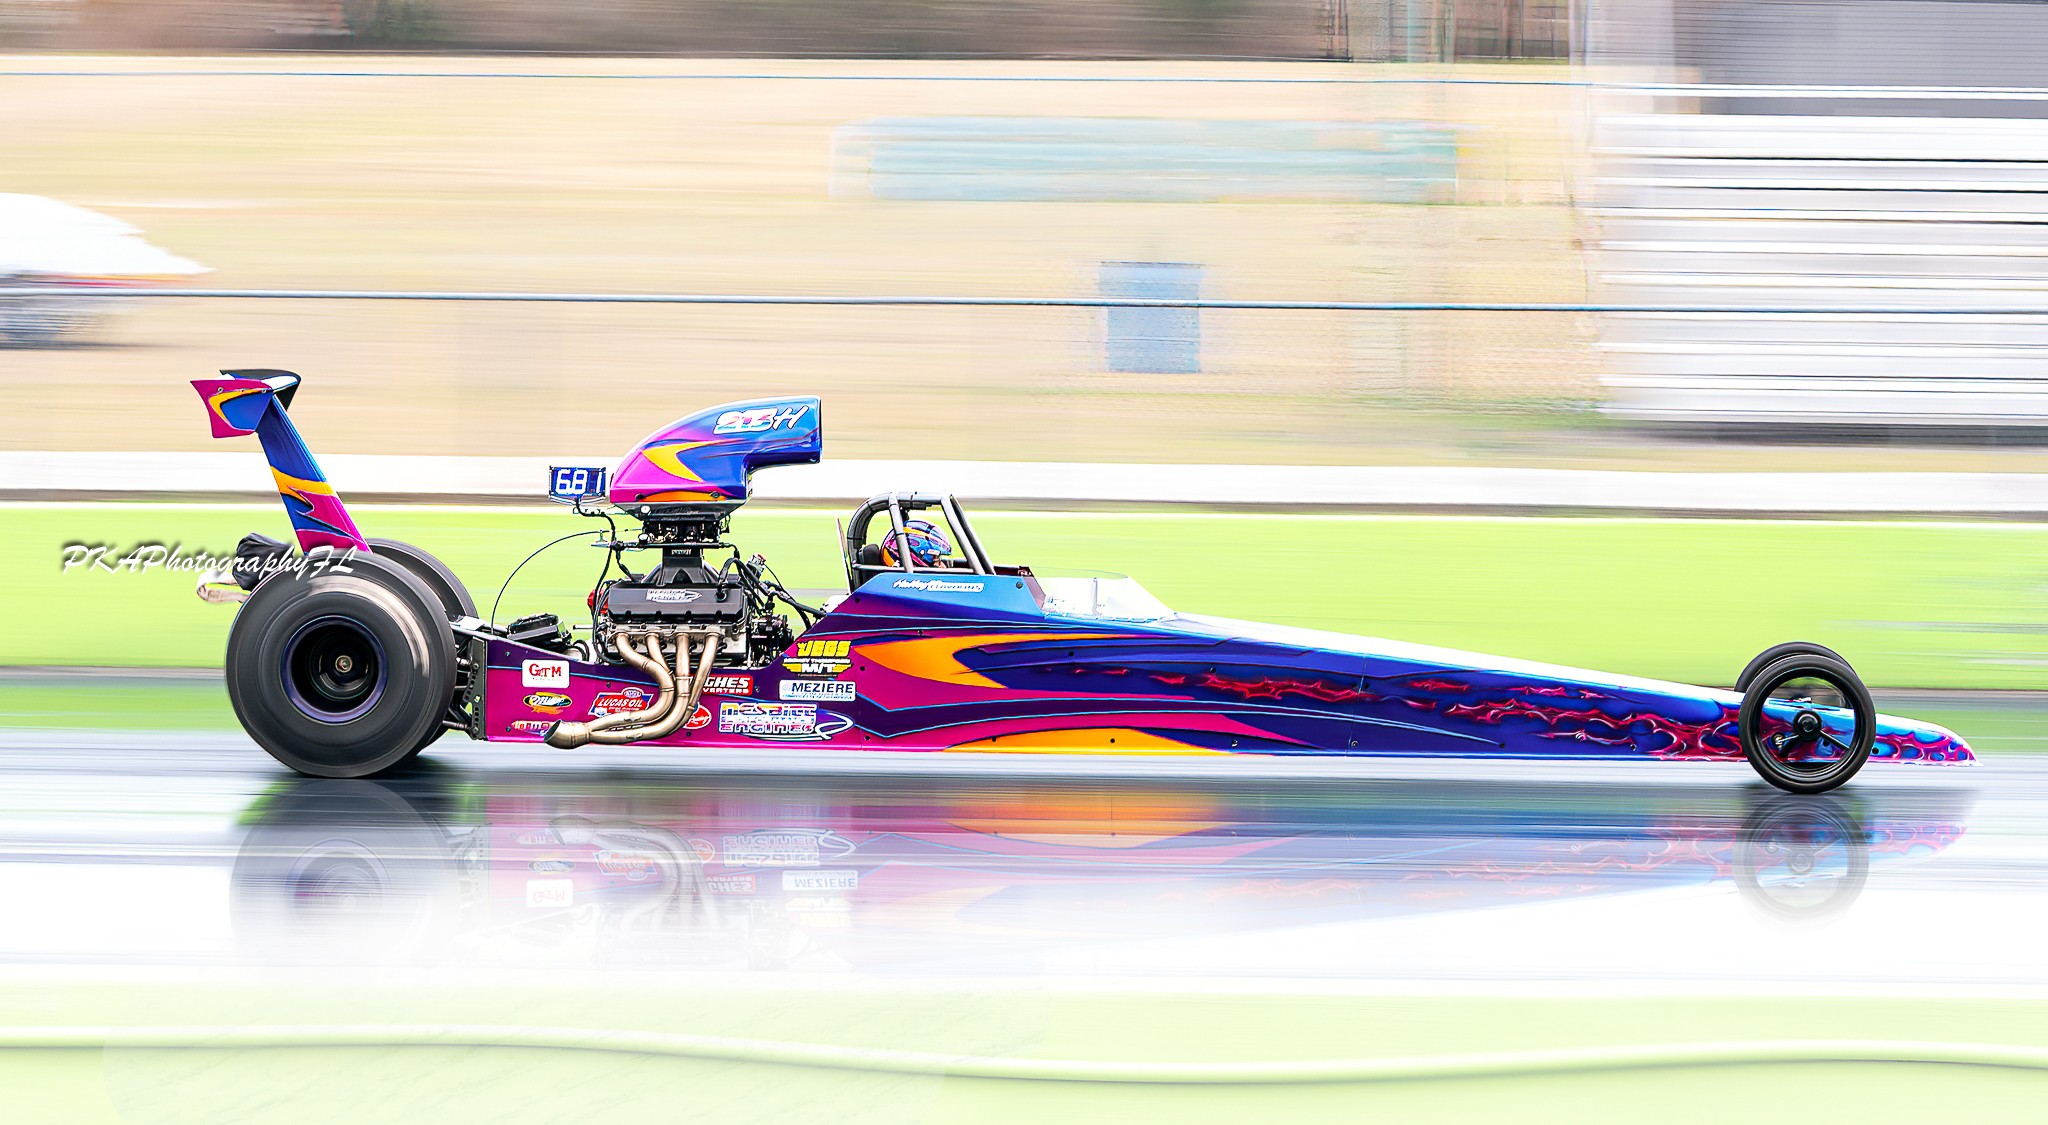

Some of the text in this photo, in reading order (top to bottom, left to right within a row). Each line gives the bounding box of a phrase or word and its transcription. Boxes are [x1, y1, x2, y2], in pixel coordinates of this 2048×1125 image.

[797, 640, 852, 657] JEGS
[703, 676, 751, 688] GHES
[791, 682, 854, 693] MEZIERE
[597, 698, 643, 707] LUCAS OIL
